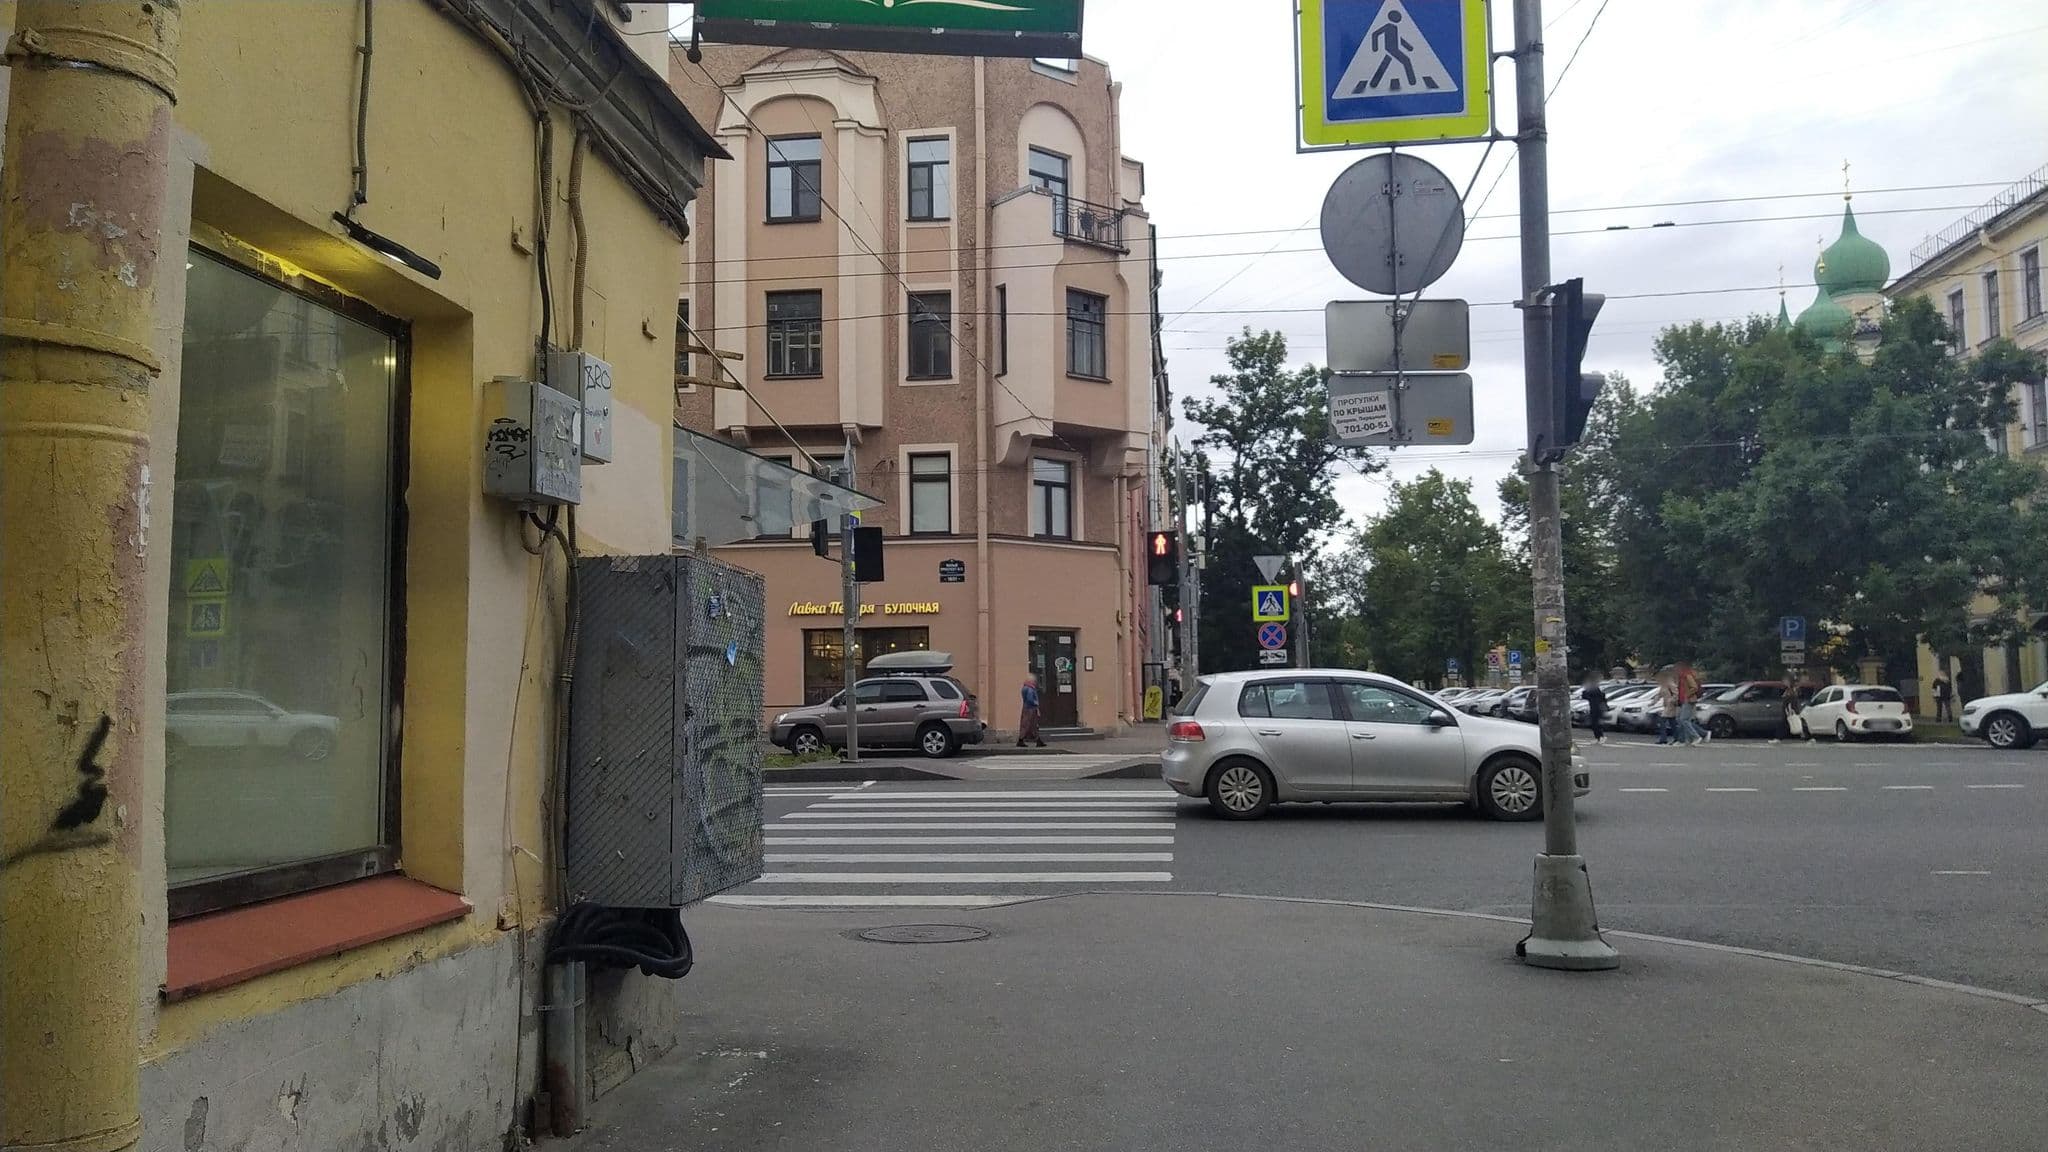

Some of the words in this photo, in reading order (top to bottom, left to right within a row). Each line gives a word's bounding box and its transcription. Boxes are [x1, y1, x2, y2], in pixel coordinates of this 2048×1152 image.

[1337, 396, 1379, 406] ПРОГУЛКИ
[1333, 409, 1345, 417] ПО
[1346, 404, 1387, 416] КРЫШАМ
[1344, 421, 1390, 433] 701-00-51
[788, 601, 826, 616] Лавка
[828, 601, 875, 617] Перя
[884, 602, 940, 615] БУЛОЧНАЯ
